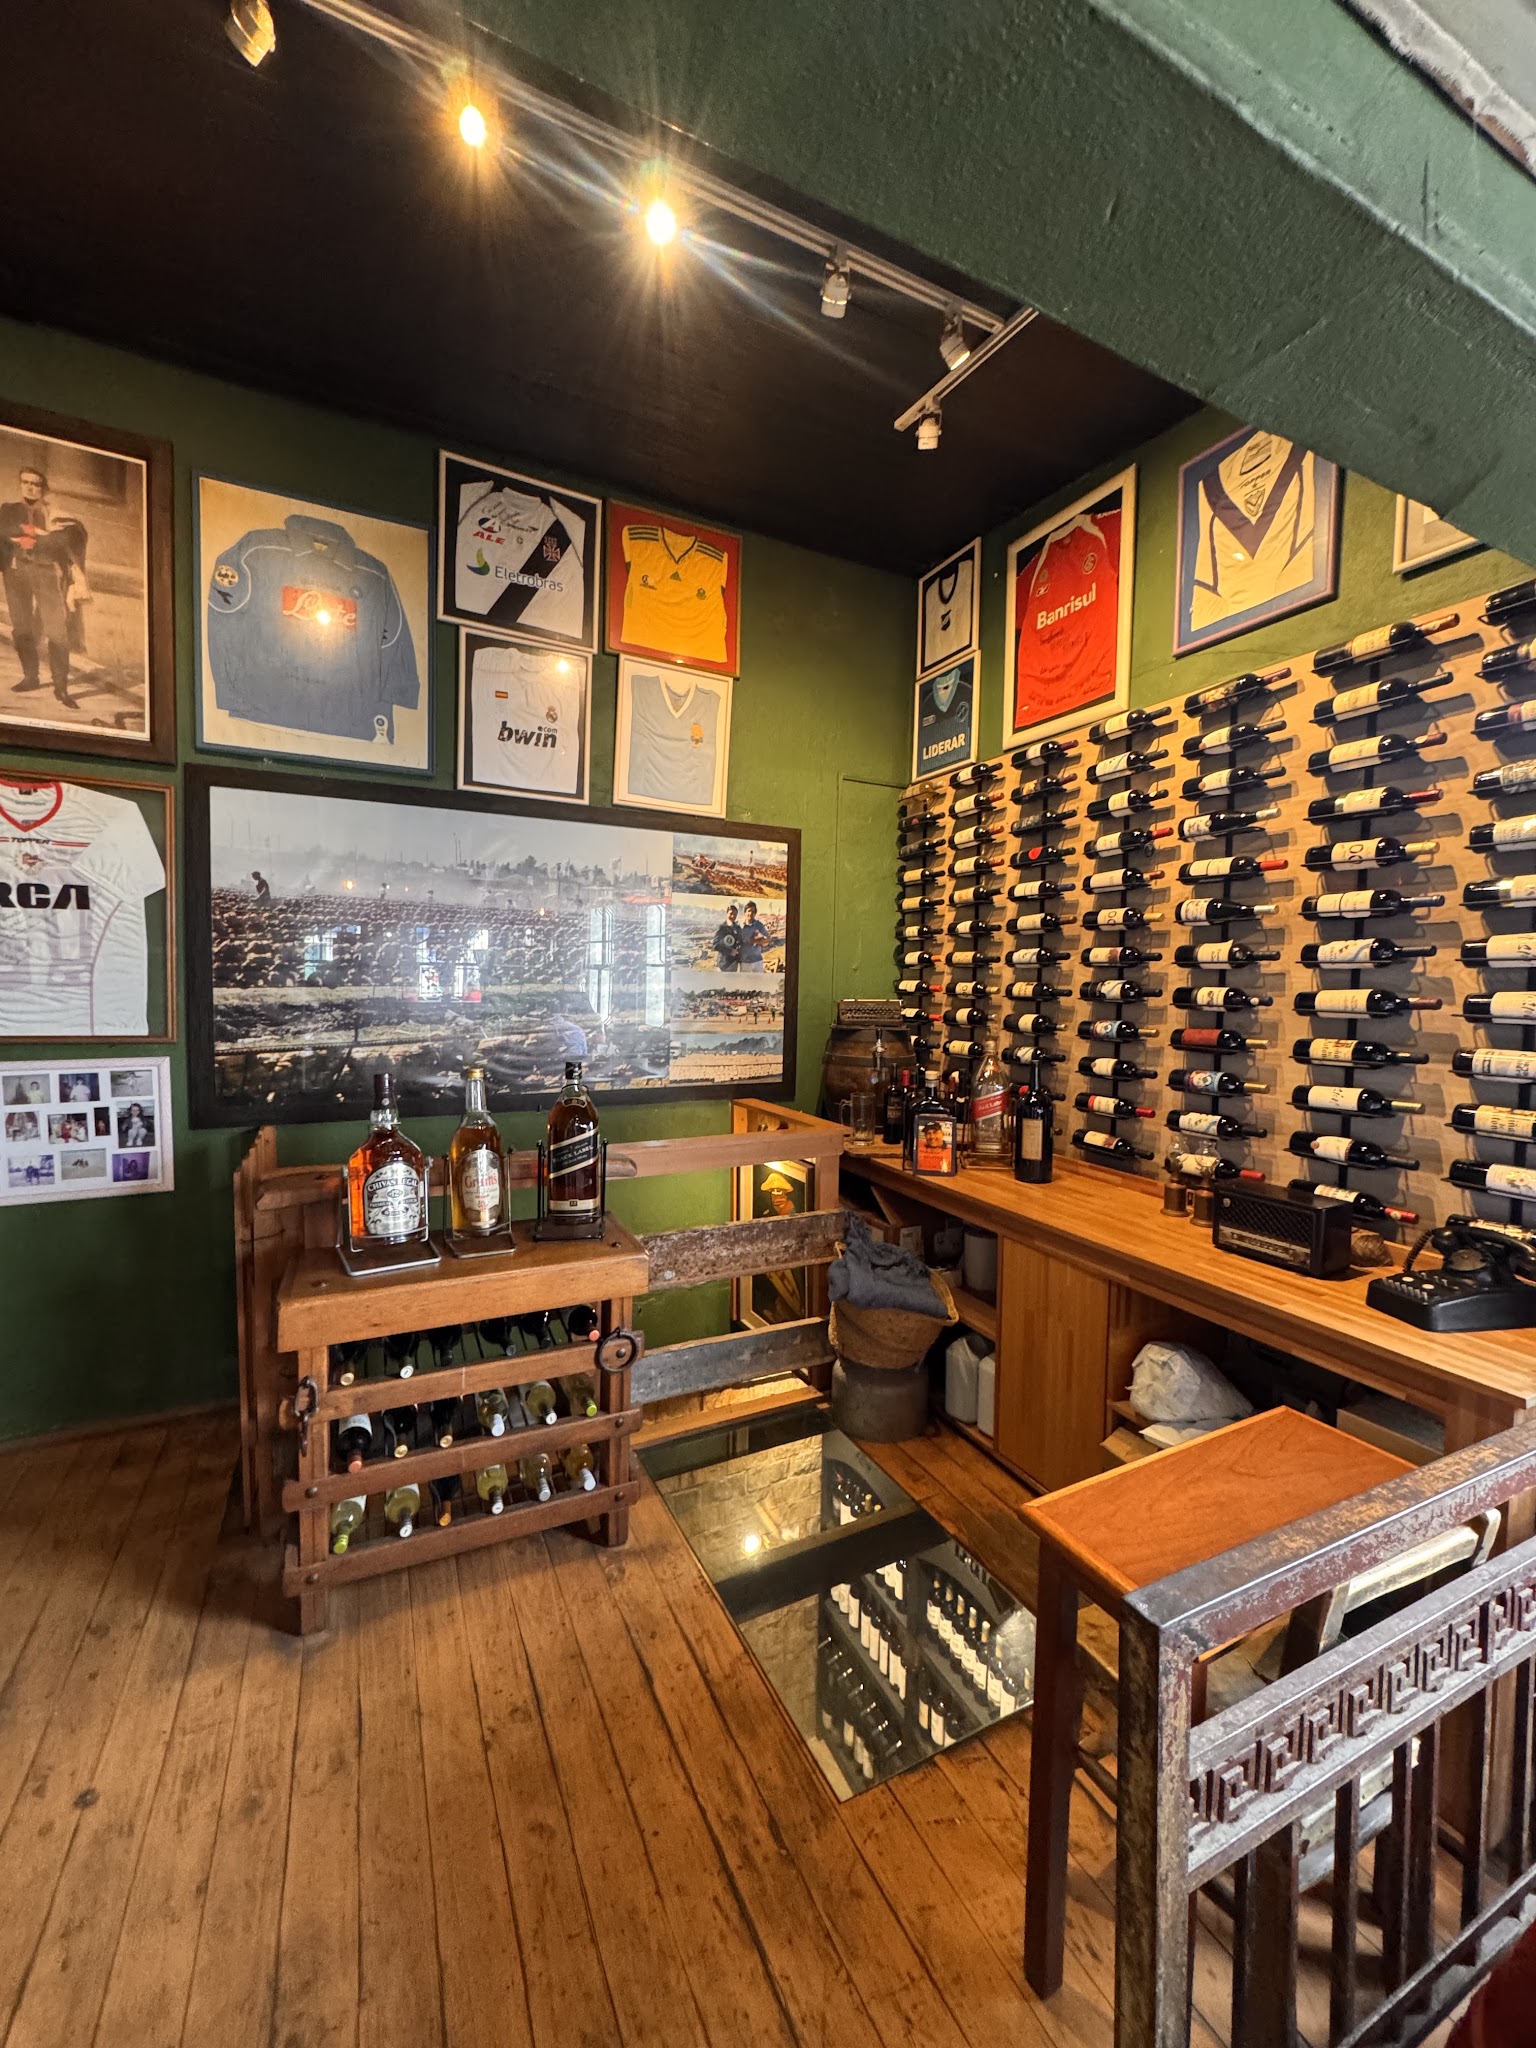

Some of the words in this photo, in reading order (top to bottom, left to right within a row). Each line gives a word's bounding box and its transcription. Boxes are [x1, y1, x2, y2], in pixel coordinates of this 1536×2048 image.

[473, 531, 506, 545] ALE
[495, 565, 564, 592] Eletrobras
[1036, 582, 1097, 630] Banrisul
[498, 721, 557, 748] bwin
[922, 733, 966, 760] LIDERAR
[11, 836, 50, 845] TOPPER
[367, 1179, 396, 1192] CHIVAS
